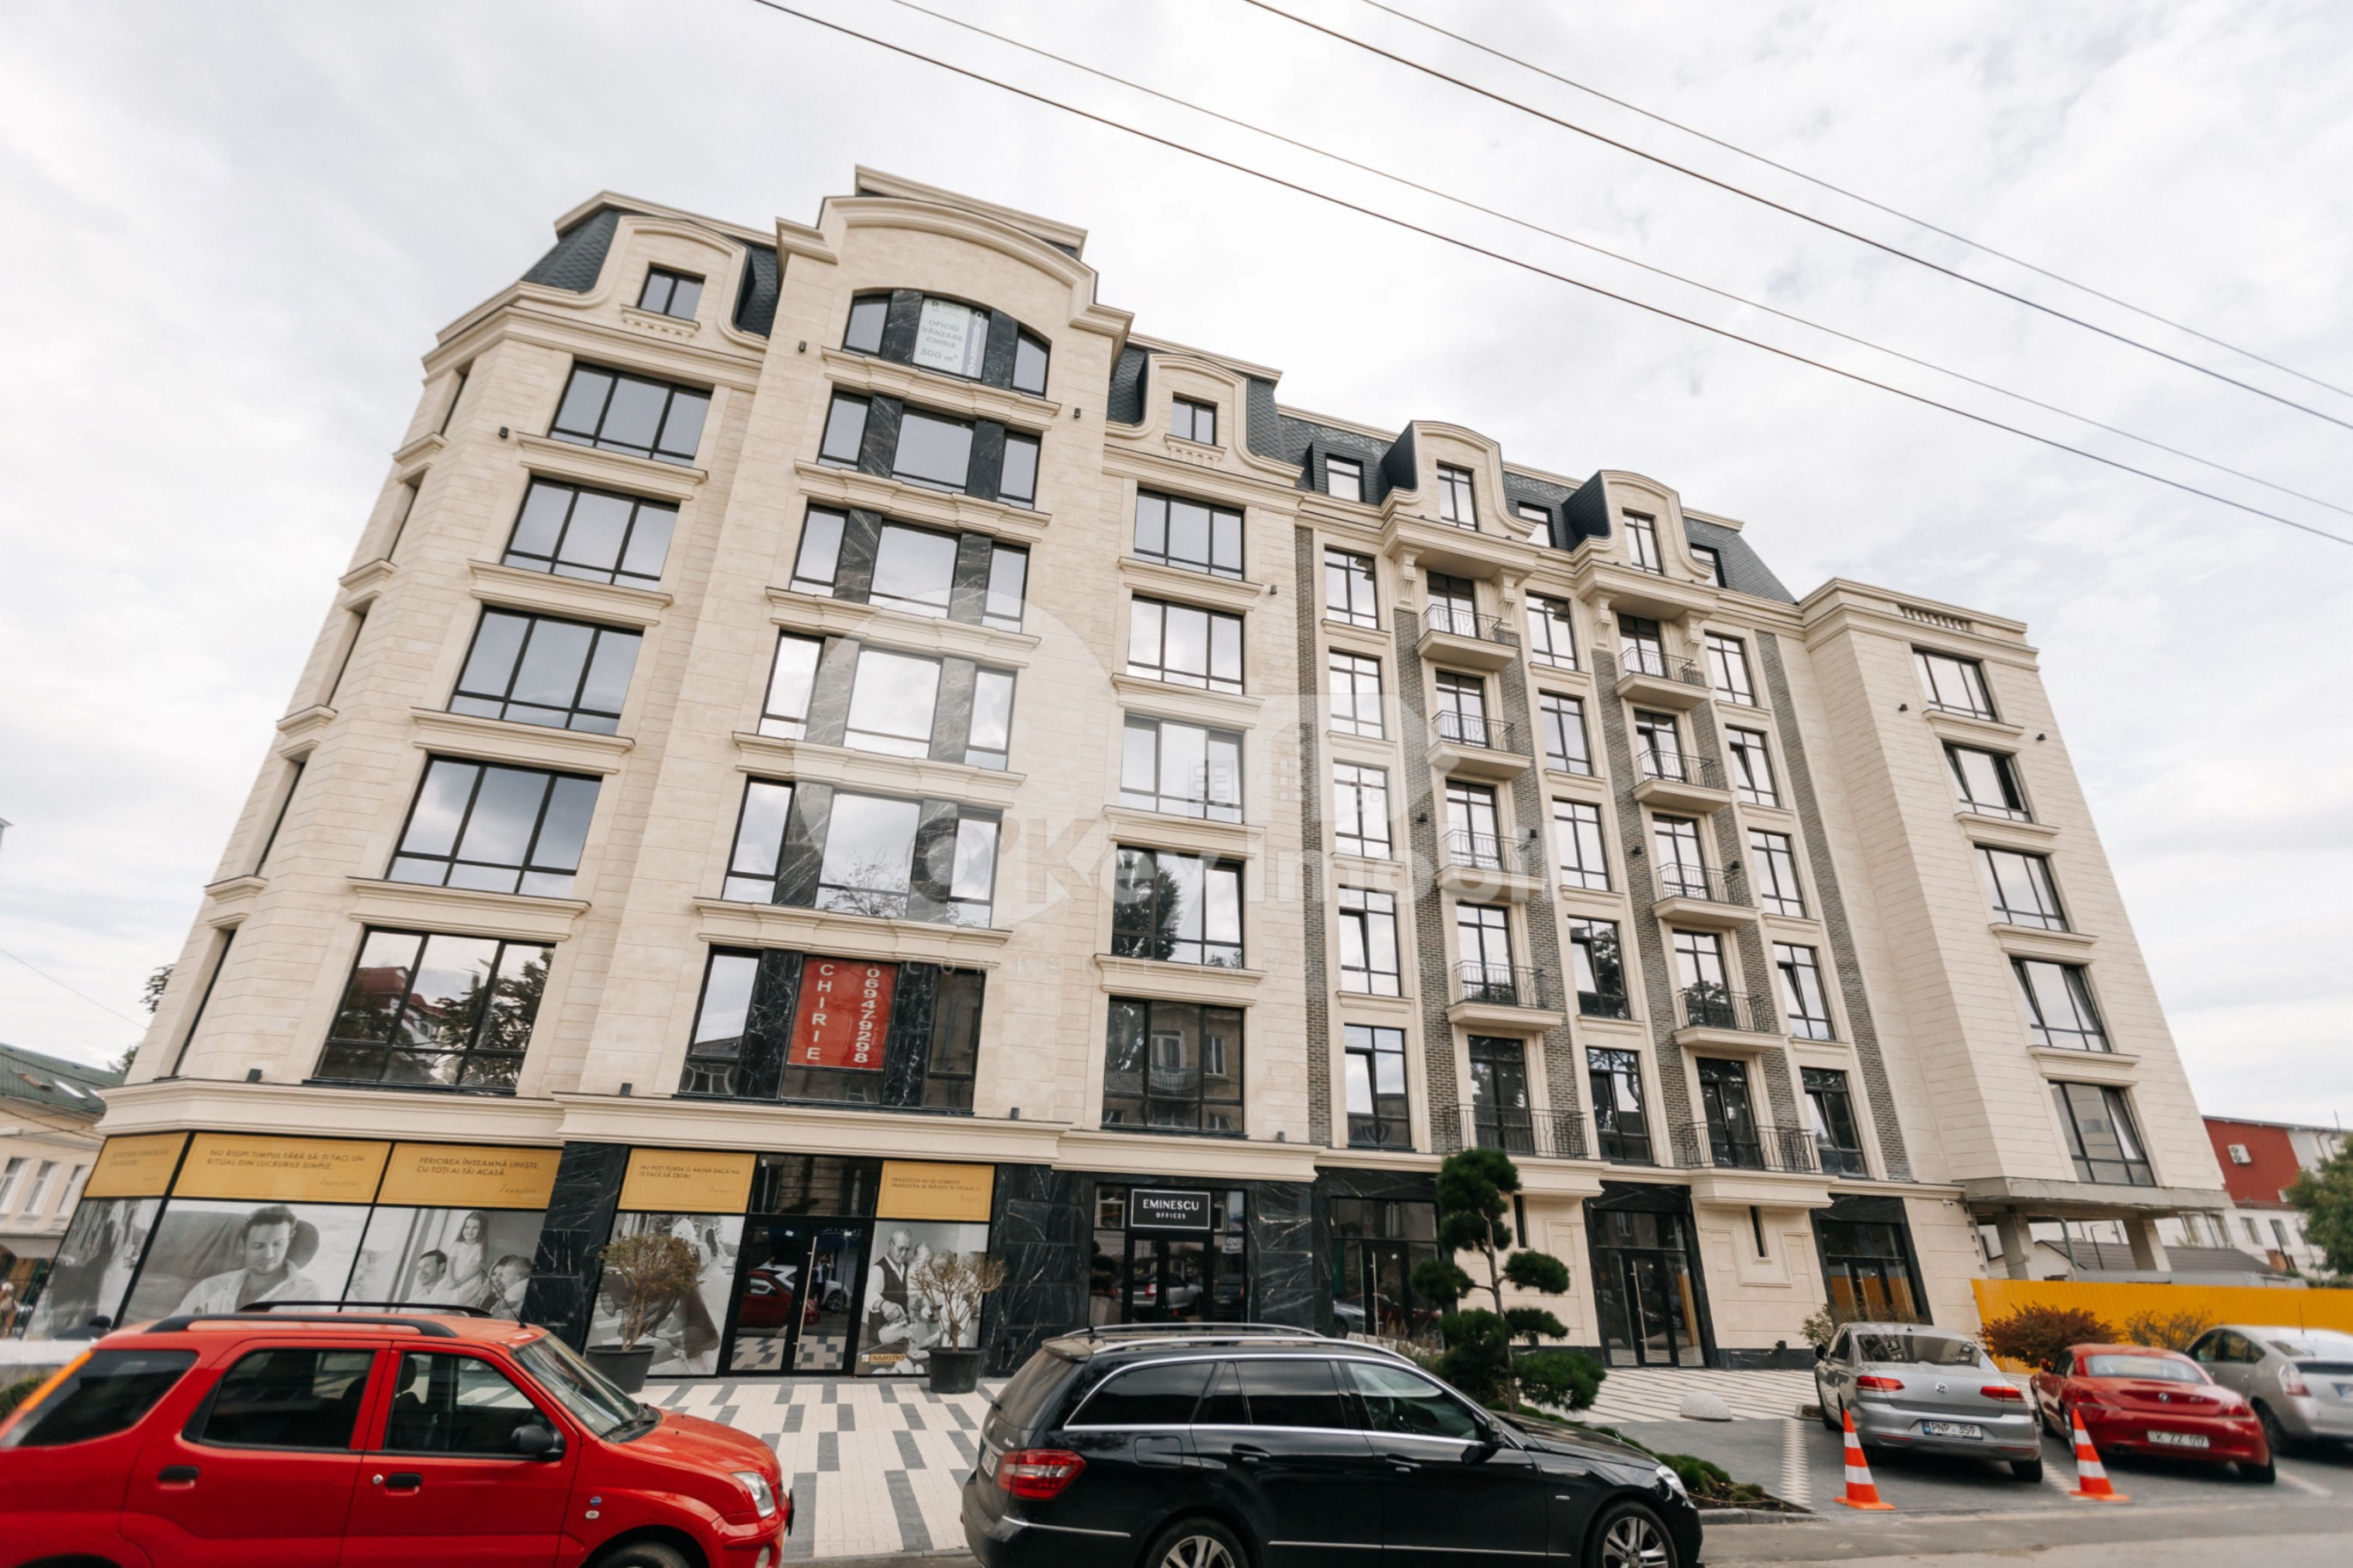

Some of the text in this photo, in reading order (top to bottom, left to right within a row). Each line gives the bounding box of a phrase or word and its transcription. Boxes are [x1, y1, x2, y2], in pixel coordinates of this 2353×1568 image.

[929, 319, 960, 332] OFICIU
[926, 336, 956, 349] CHIRIE
[920, 348, 942, 359] 300
[806, 964, 835, 1060] CHIRIE
[853, 968, 881, 1064] 069479298
[1143, 1199, 1199, 1211] EMINESCU
